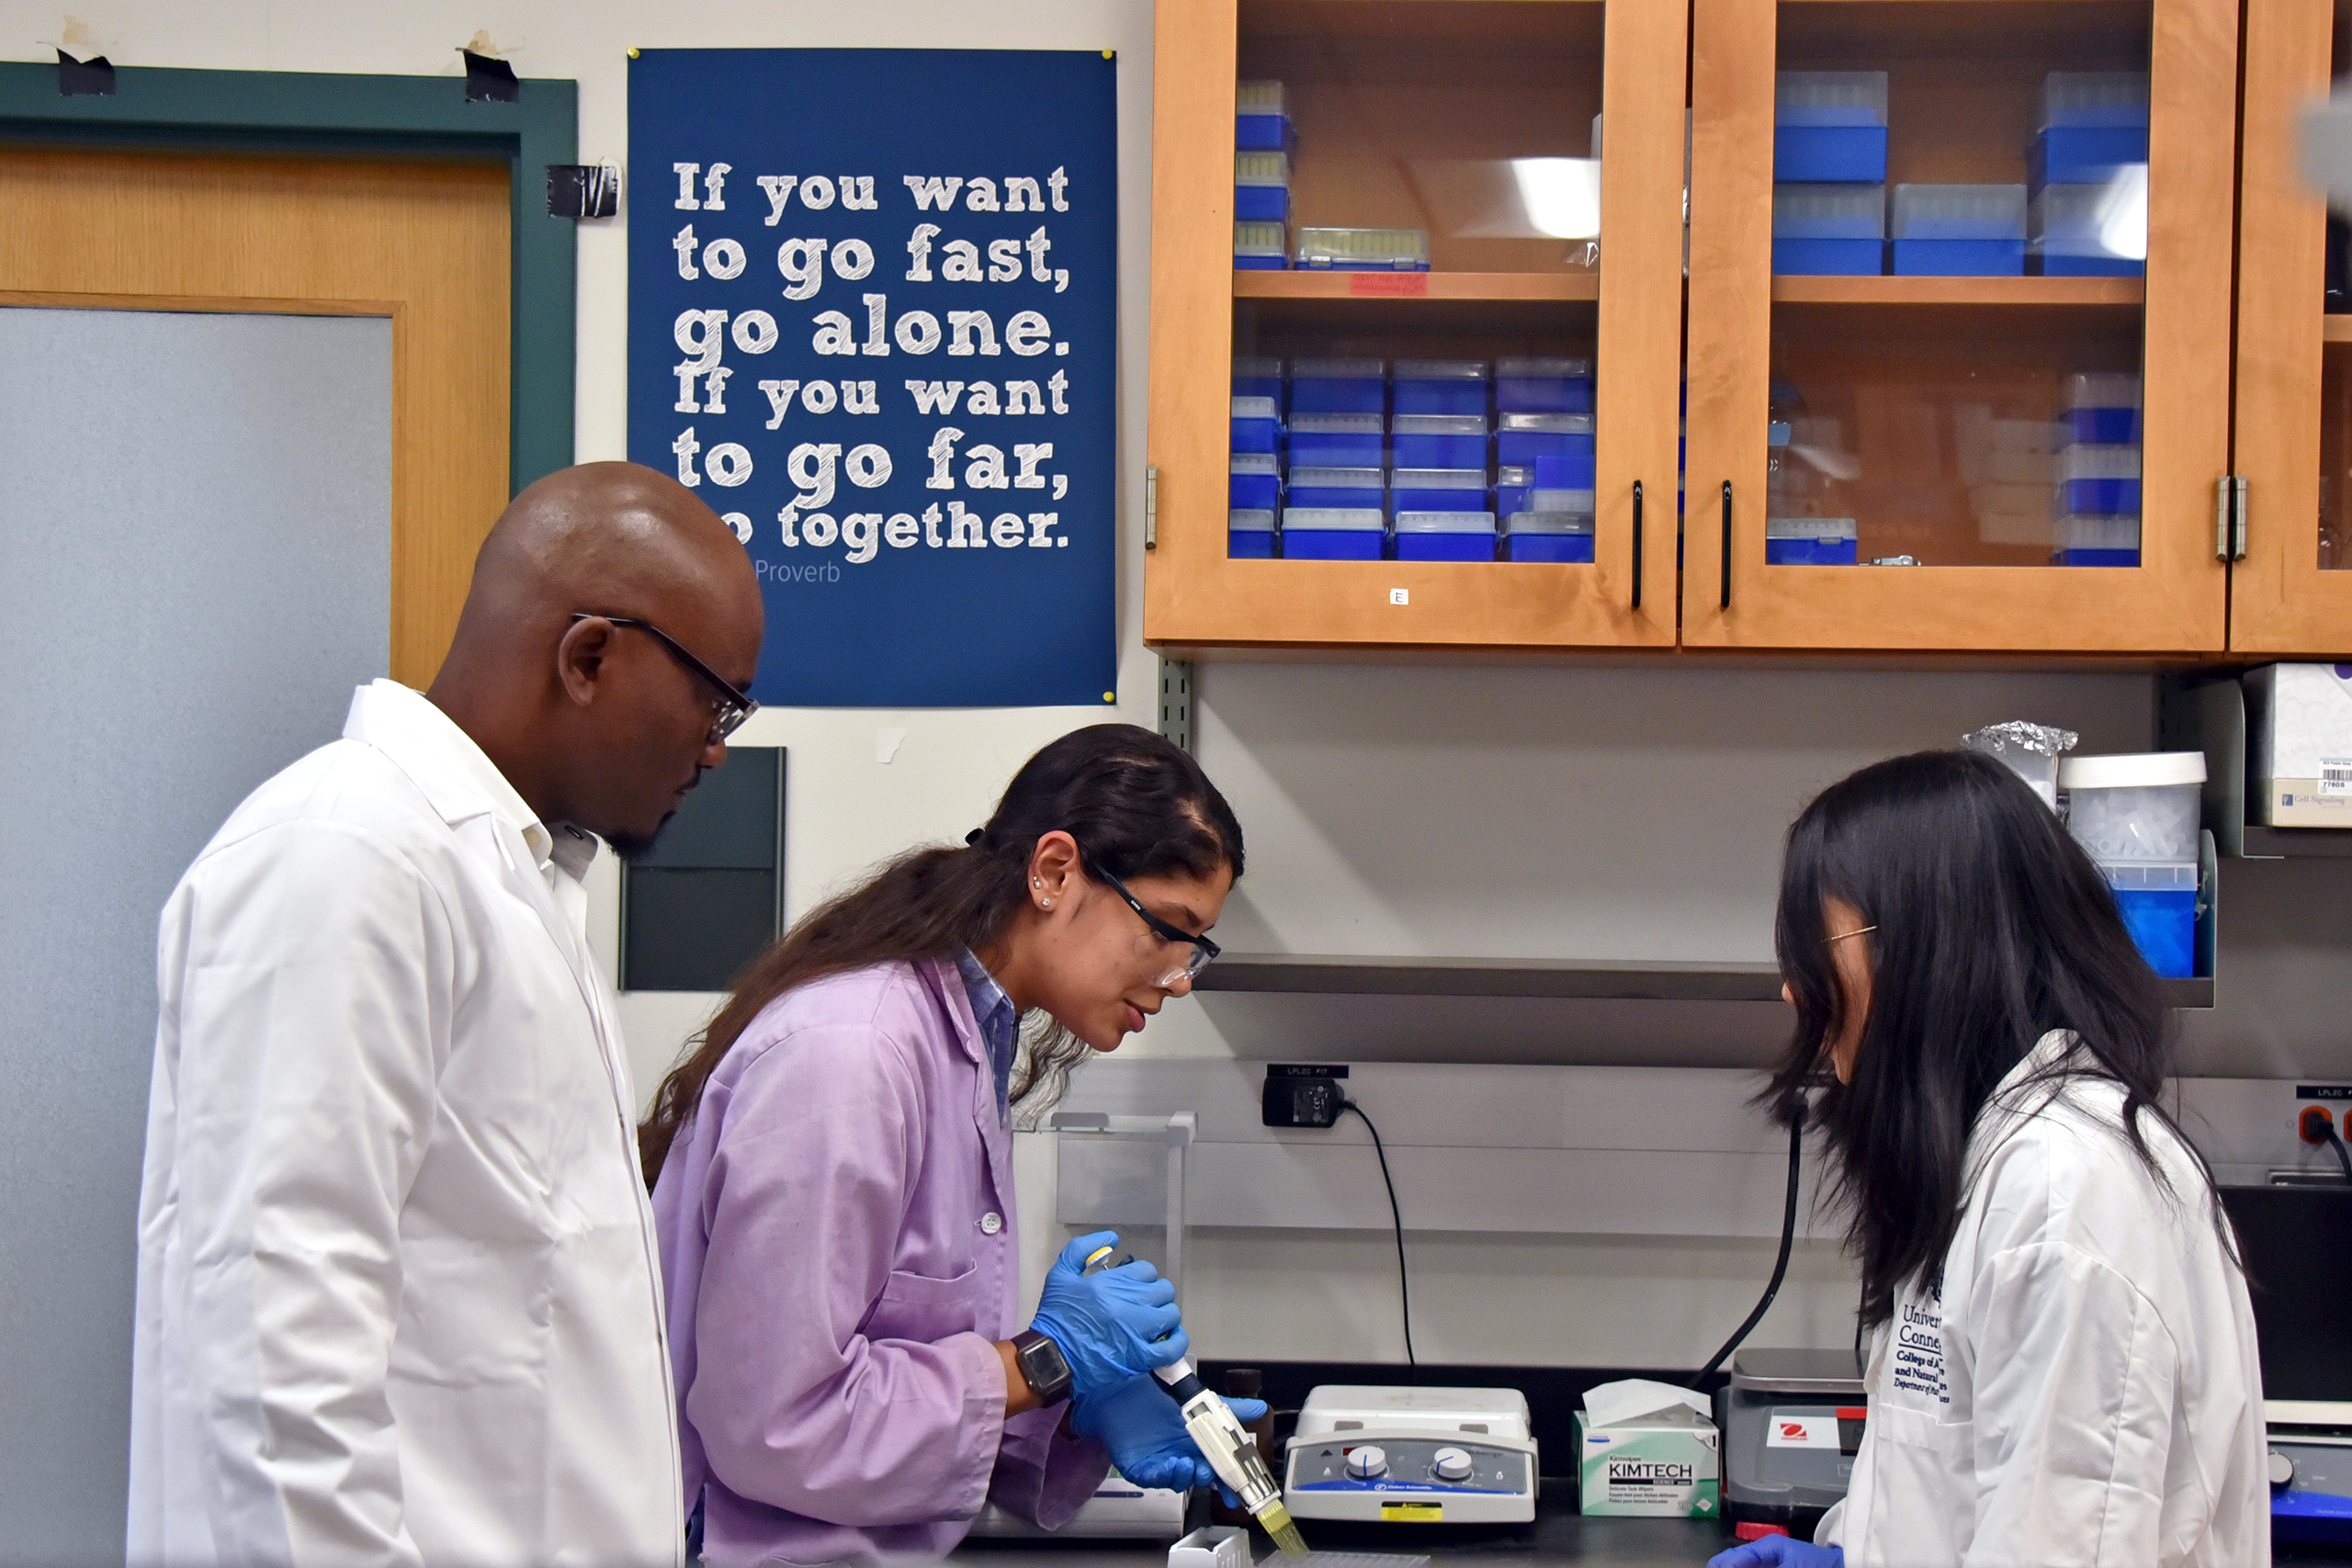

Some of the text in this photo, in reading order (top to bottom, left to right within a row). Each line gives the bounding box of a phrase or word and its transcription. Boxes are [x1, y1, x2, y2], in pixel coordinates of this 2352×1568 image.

[673, 163, 1069, 226] If you want
[673, 223, 1069, 300] to go fast,
[673, 294, 1069, 374] go alone.
[673, 366, 1069, 430] If you want
[673, 427, 1069, 509] to go far,
[721, 502, 1069, 564] o together.
[755, 559, 841, 583] Proverb
[1395, 592, 1404, 604] E
[2294, 795, 2346, 806] Cell Signaling
[1903, 1304, 1942, 1329] Univer
[1899, 1325, 1941, 1350] Conne
[1896, 1350, 1926, 1367] College
[1894, 1368, 1912, 1377] and
[1912, 1367, 1939, 1383] Natural
[1609, 1463, 1693, 1478] KIMTECH
